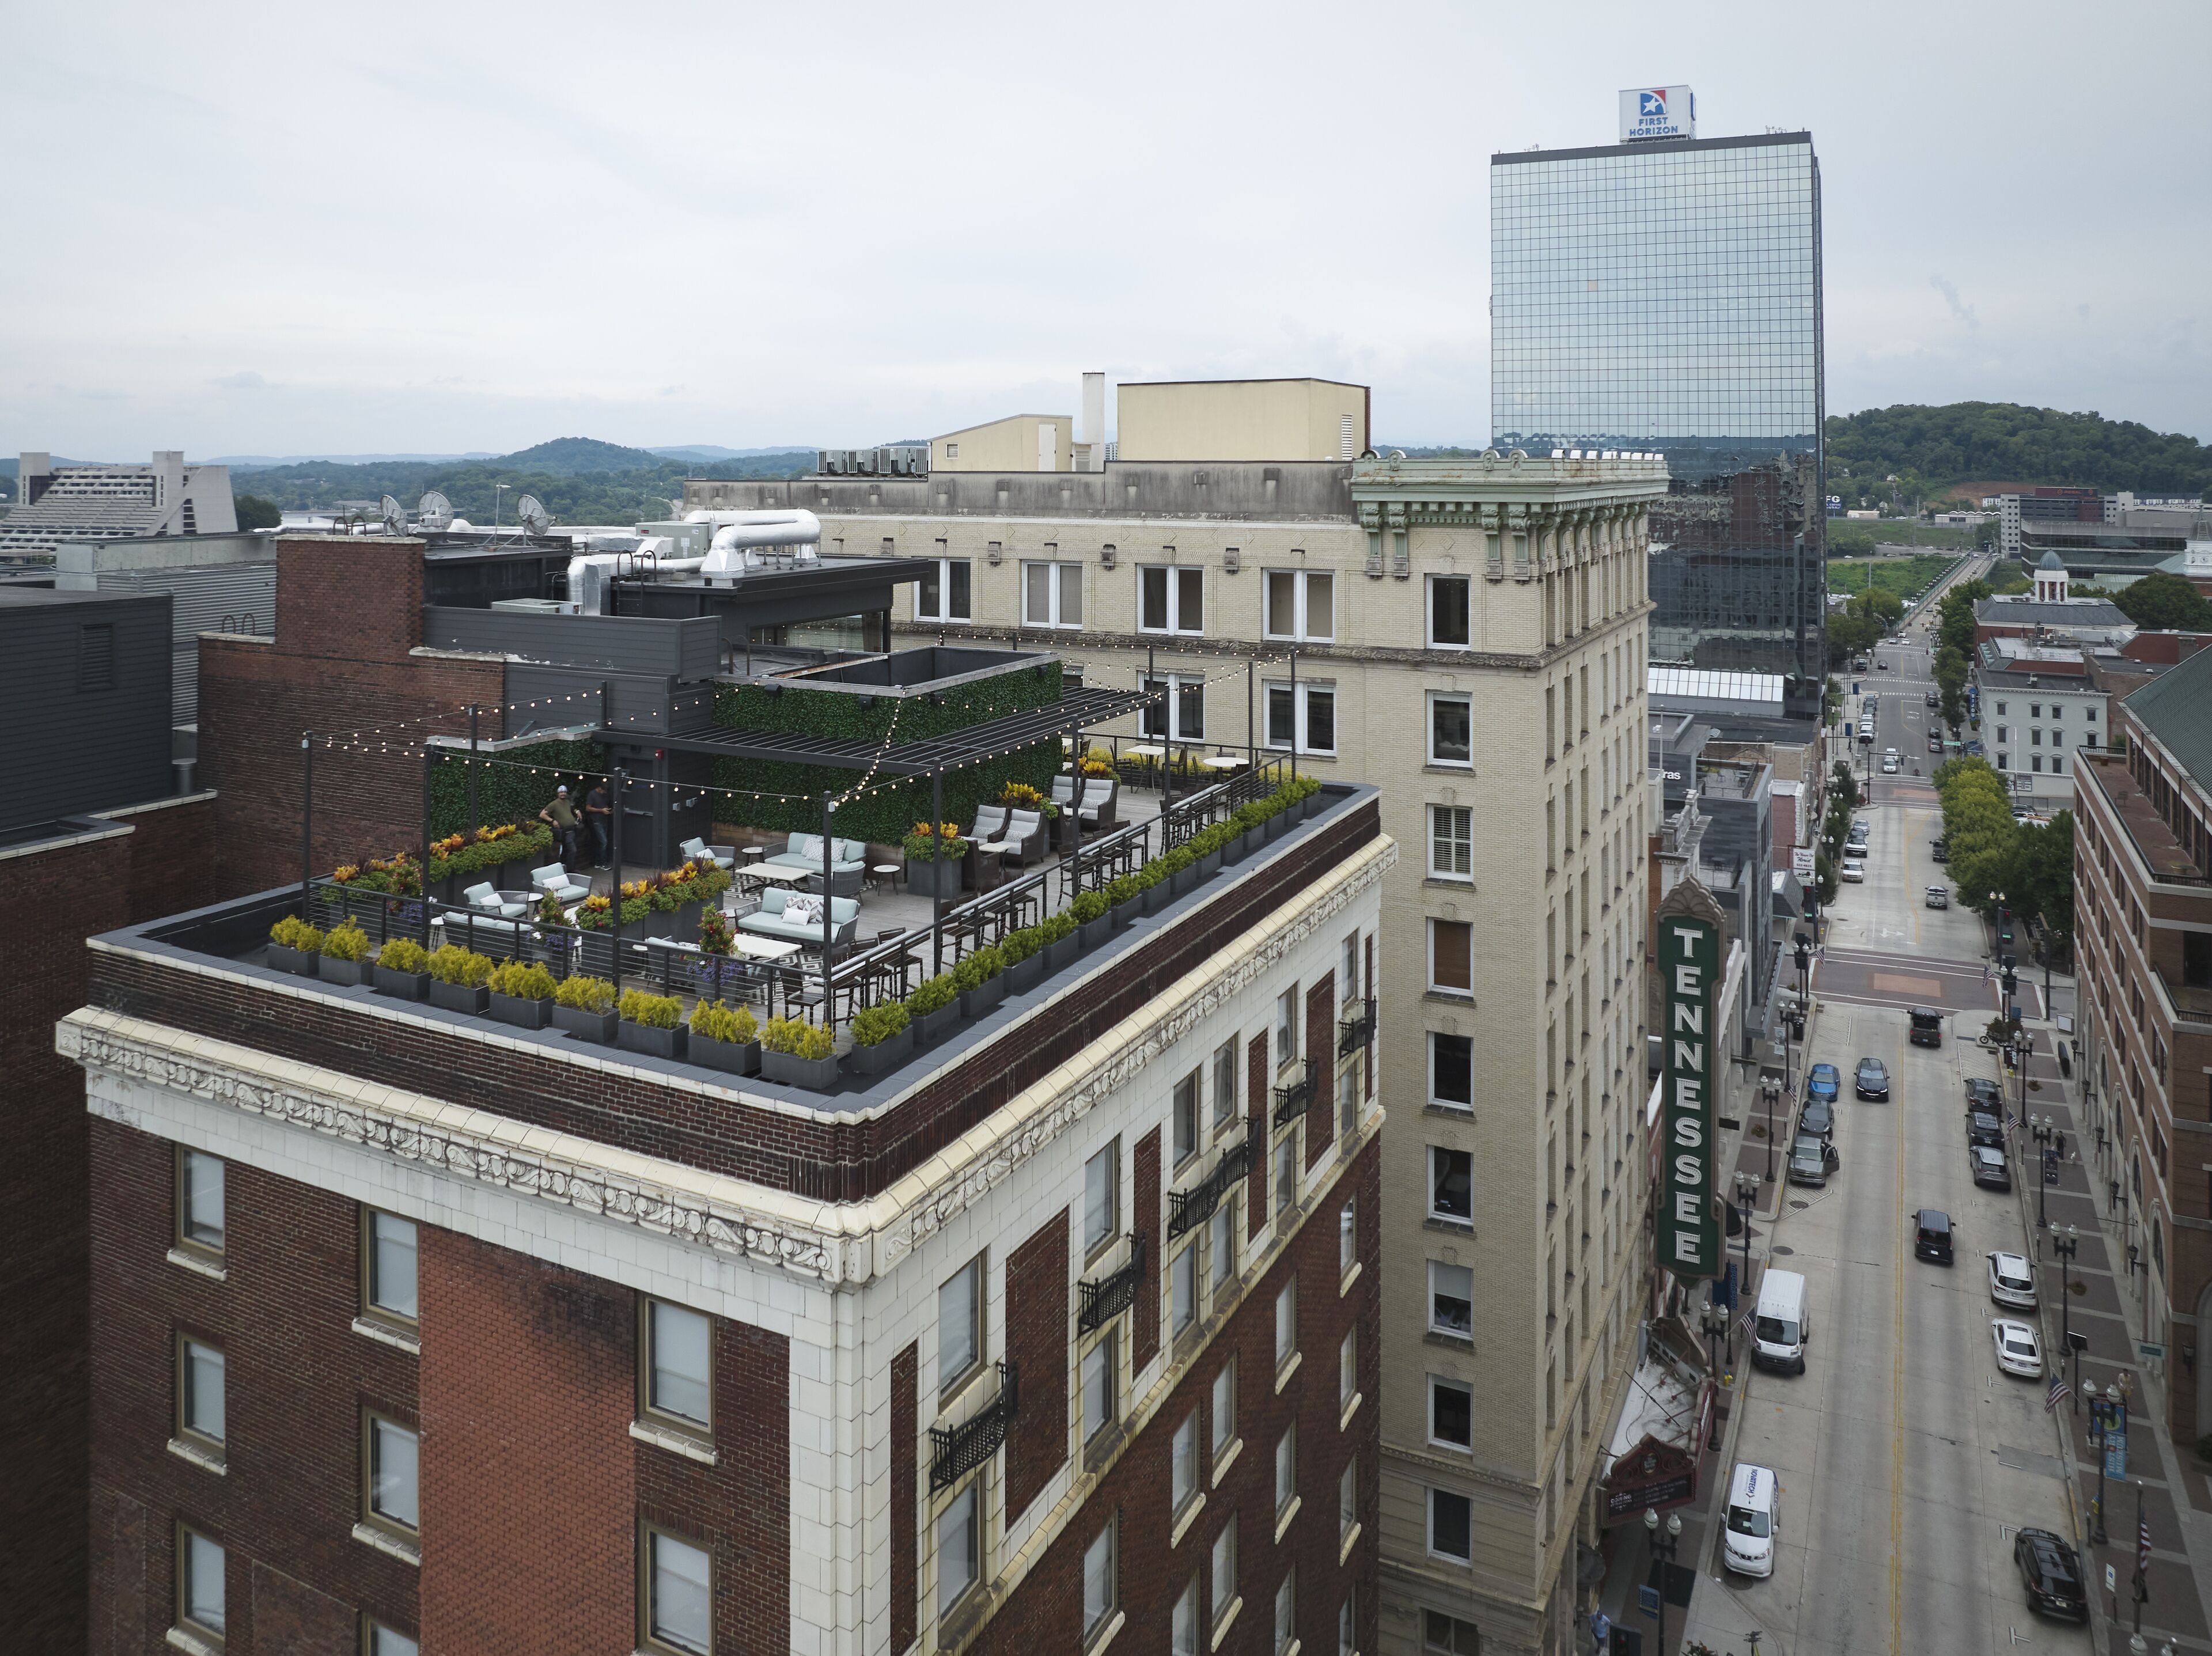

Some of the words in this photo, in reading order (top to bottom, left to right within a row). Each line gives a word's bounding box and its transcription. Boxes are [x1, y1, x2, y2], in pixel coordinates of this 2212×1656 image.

[1630, 126, 1678, 137] HORIZON
[1639, 117, 1668, 126] FIRST
[1663, 771, 1681, 780] ras
[1673, 926, 1703, 1264] TENNESSEE
[2108, 1434, 2116, 1472] HISTRY
[2115, 1435, 2126, 1475] MUSEUM
[1748, 1468, 1758, 1494] NOVATECH
